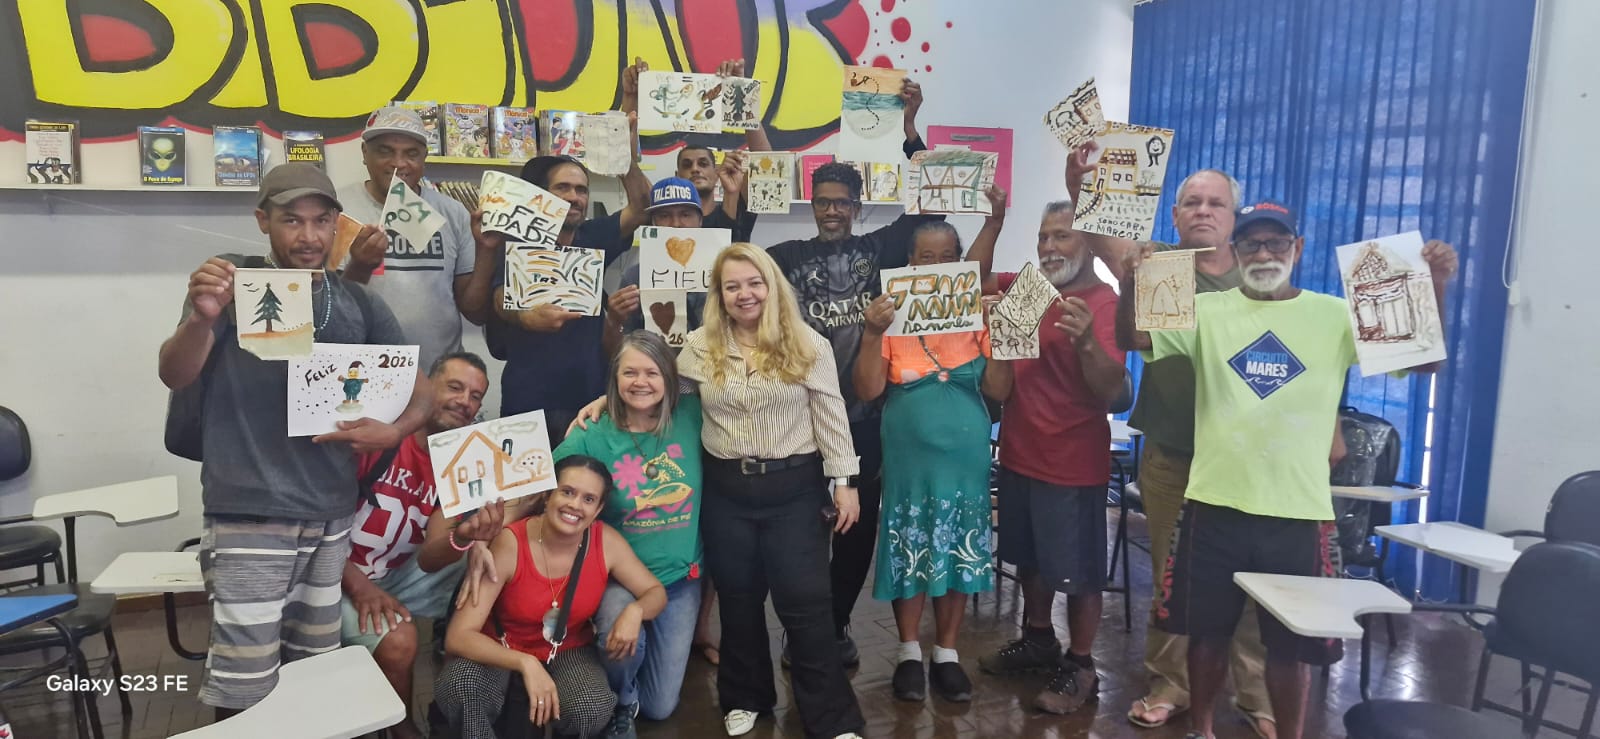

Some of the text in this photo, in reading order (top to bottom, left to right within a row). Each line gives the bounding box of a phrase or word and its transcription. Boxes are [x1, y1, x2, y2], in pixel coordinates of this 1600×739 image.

[653, 185, 692, 203] TALENTOS
[808, 291, 872, 321] QATAR
[668, 332, 684, 345] 26
[378, 353, 415, 369] 2026
[1246, 350, 1289, 364] CIRCUITO
[304, 363, 338, 388] FELIZ
[1245, 360, 1289, 378] MARES
